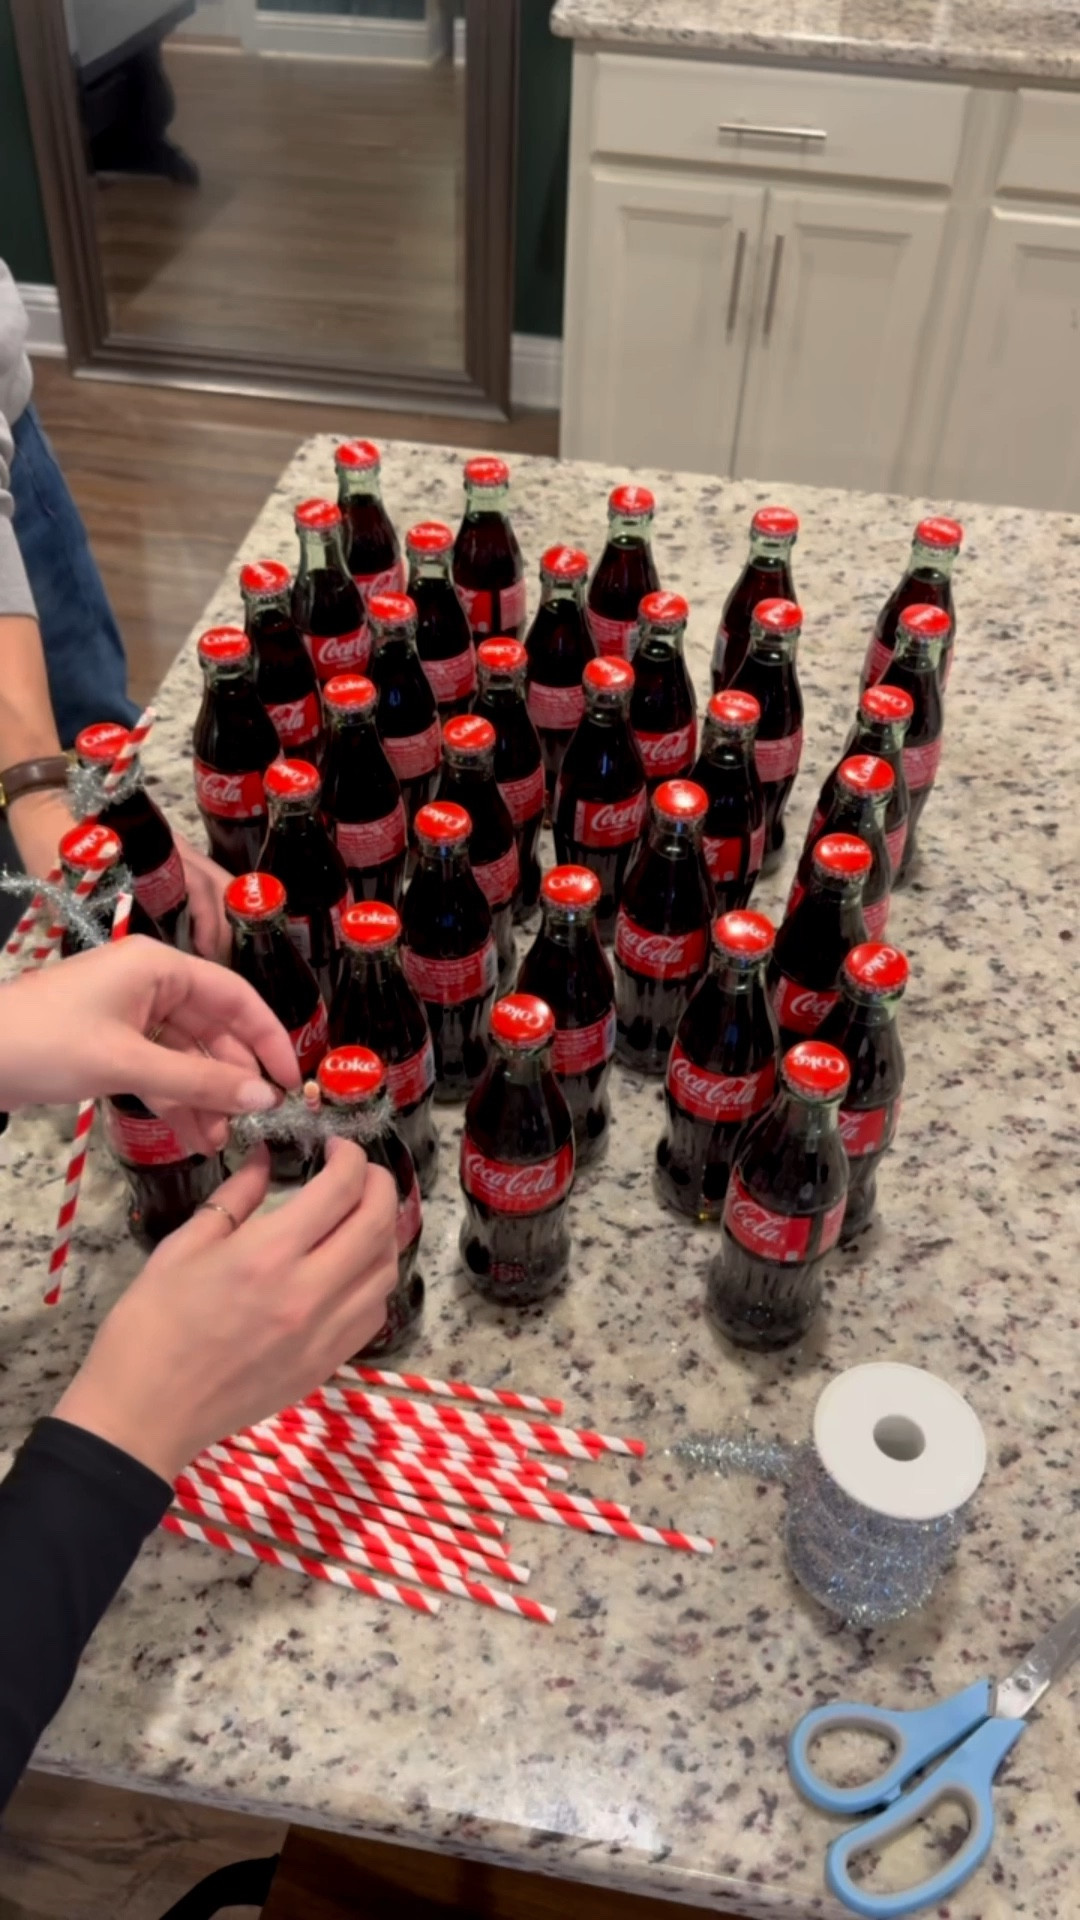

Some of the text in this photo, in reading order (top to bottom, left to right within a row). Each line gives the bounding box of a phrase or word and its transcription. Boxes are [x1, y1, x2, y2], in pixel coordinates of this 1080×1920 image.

[246, 871, 263, 908] Coke
[345, 907, 397, 925] Coke
[856, 947, 898, 980] Coke
[498, 1000, 546, 1029] Coke
[324, 1054, 379, 1073] Coke
[793, 1052, 845, 1074] Coke
[465, 1153, 557, 1196] Coca-Cola
